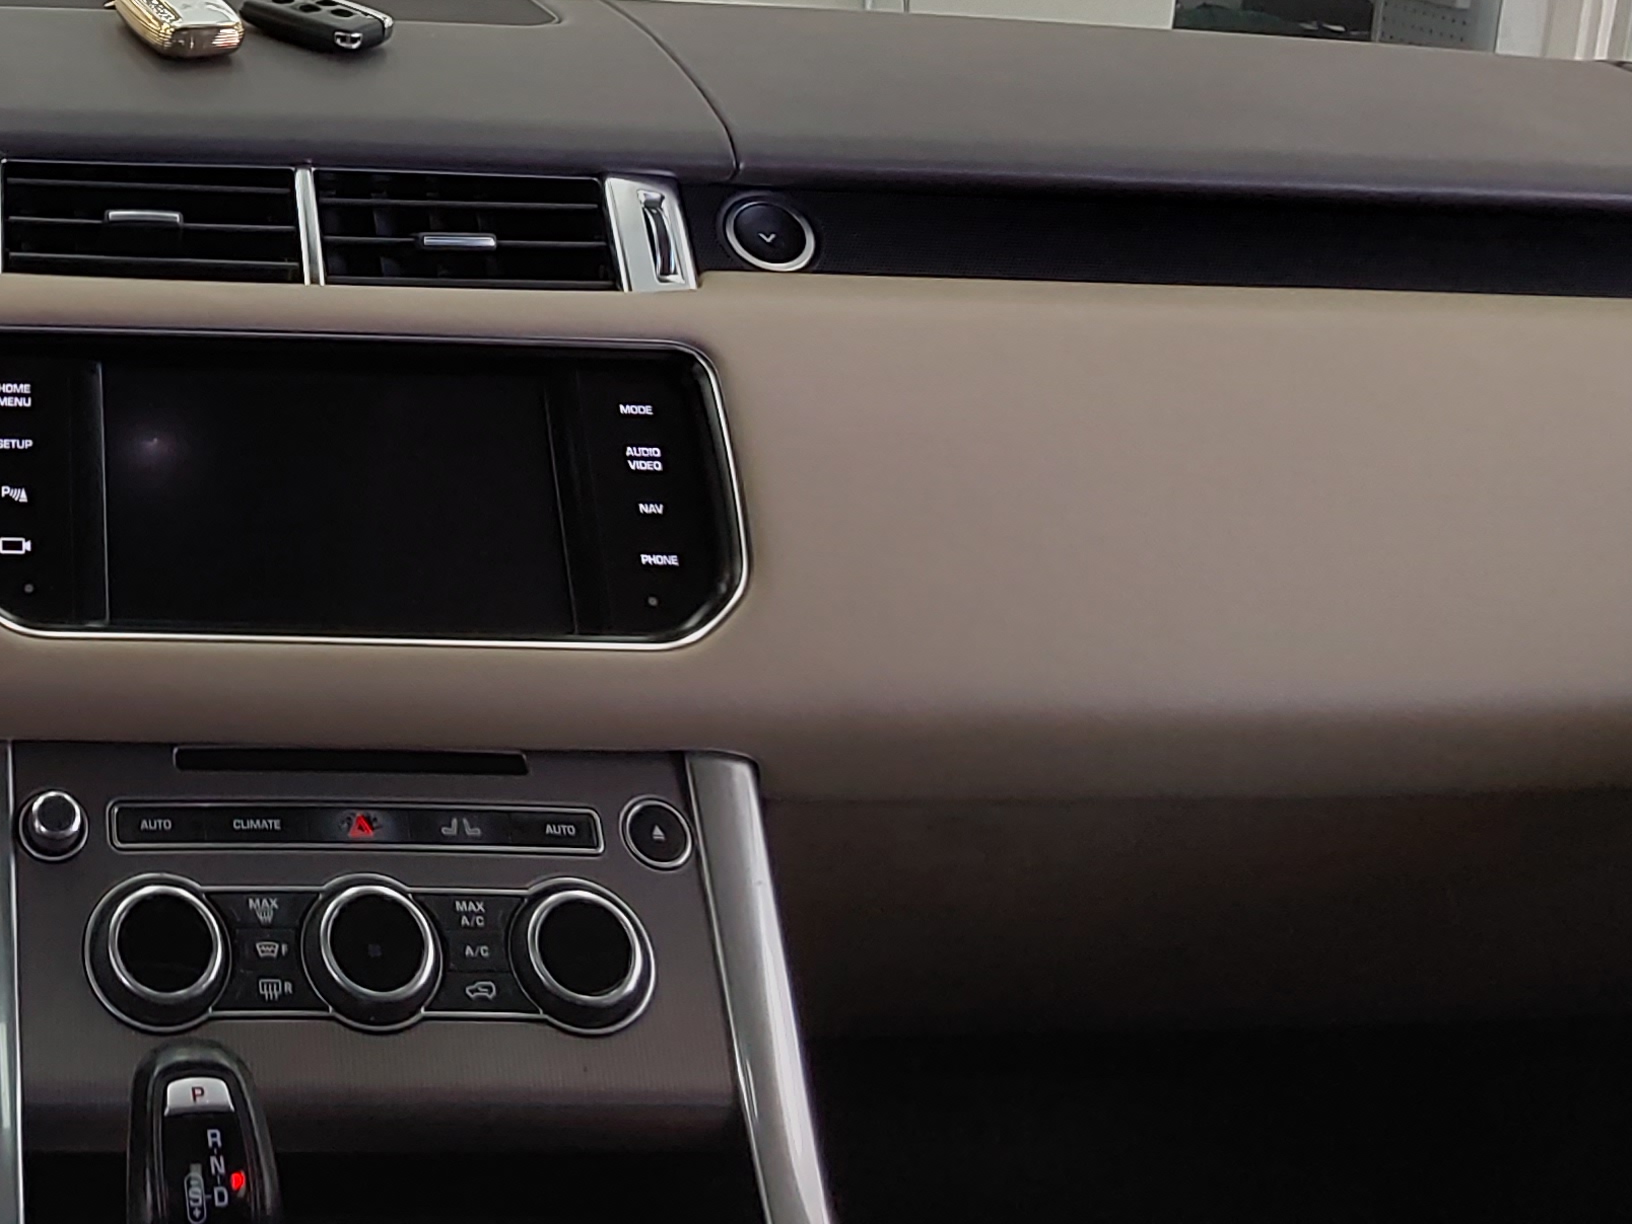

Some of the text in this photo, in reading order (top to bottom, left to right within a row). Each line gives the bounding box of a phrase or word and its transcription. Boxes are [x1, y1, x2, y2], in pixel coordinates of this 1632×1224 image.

[619, 404, 654, 416] MODE
[625, 446, 662, 458] AUDIO
[627, 459, 663, 472] VIDEO
[638, 503, 664, 515] NAV
[640, 553, 680, 567] PHONE
[140, 818, 173, 831] AUTO
[232, 818, 282, 831] CLIMATE
[545, 823, 577, 836] AUTO
[248, 897, 279, 911] MAX
[455, 900, 486, 913] MAX
[460, 915, 485, 927] A/C
[464, 945, 490, 958] A/C
[284, 980, 294, 995] R
[191, 1085, 206, 1104] P
[207, 1128, 222, 1149] R
[209, 1155, 226, 1176] N
[213, 1186, 228, 1208] D
